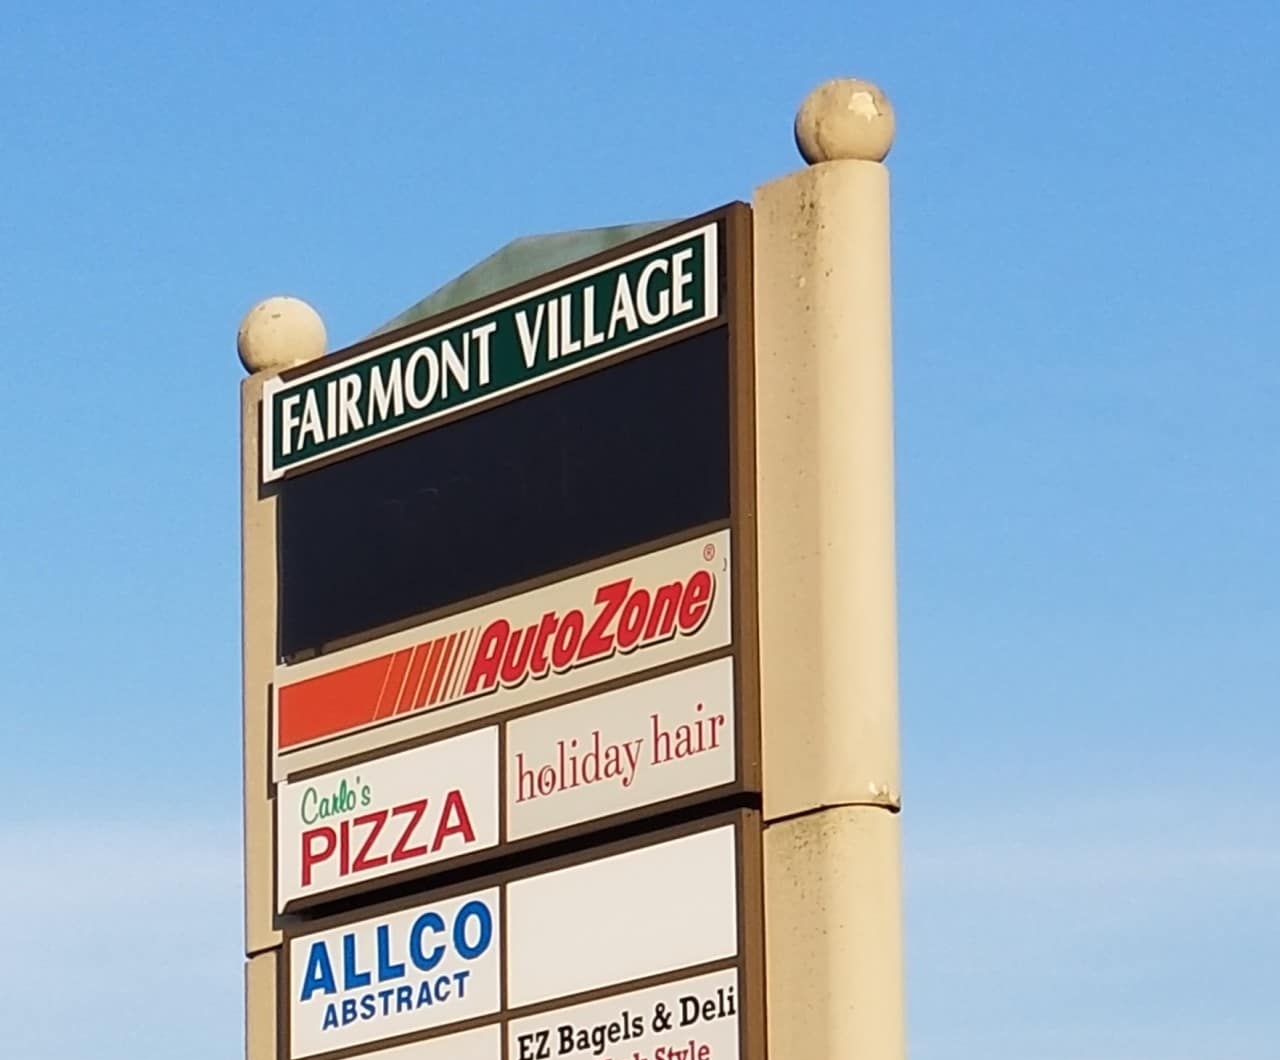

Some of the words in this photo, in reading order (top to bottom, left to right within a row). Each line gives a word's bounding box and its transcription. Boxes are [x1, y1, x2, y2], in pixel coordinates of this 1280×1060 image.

[280, 322, 497, 457] FAIRMONT
[514, 247, 695, 369] VILLAGE
[464, 569, 716, 696] AutoZone
[300, 776, 372, 825] Carlo's
[515, 731, 643, 803] holiday
[650, 703, 725, 766] hair
[300, 789, 477, 888] PIZZA
[299, 899, 494, 1003] ALLCO
[322, 969, 471, 1031] ABSTRACT
[557, 1011, 645, 1055] Bagels
[652, 1002, 673, 1033] &
[679, 986, 737, 1027] Deli
